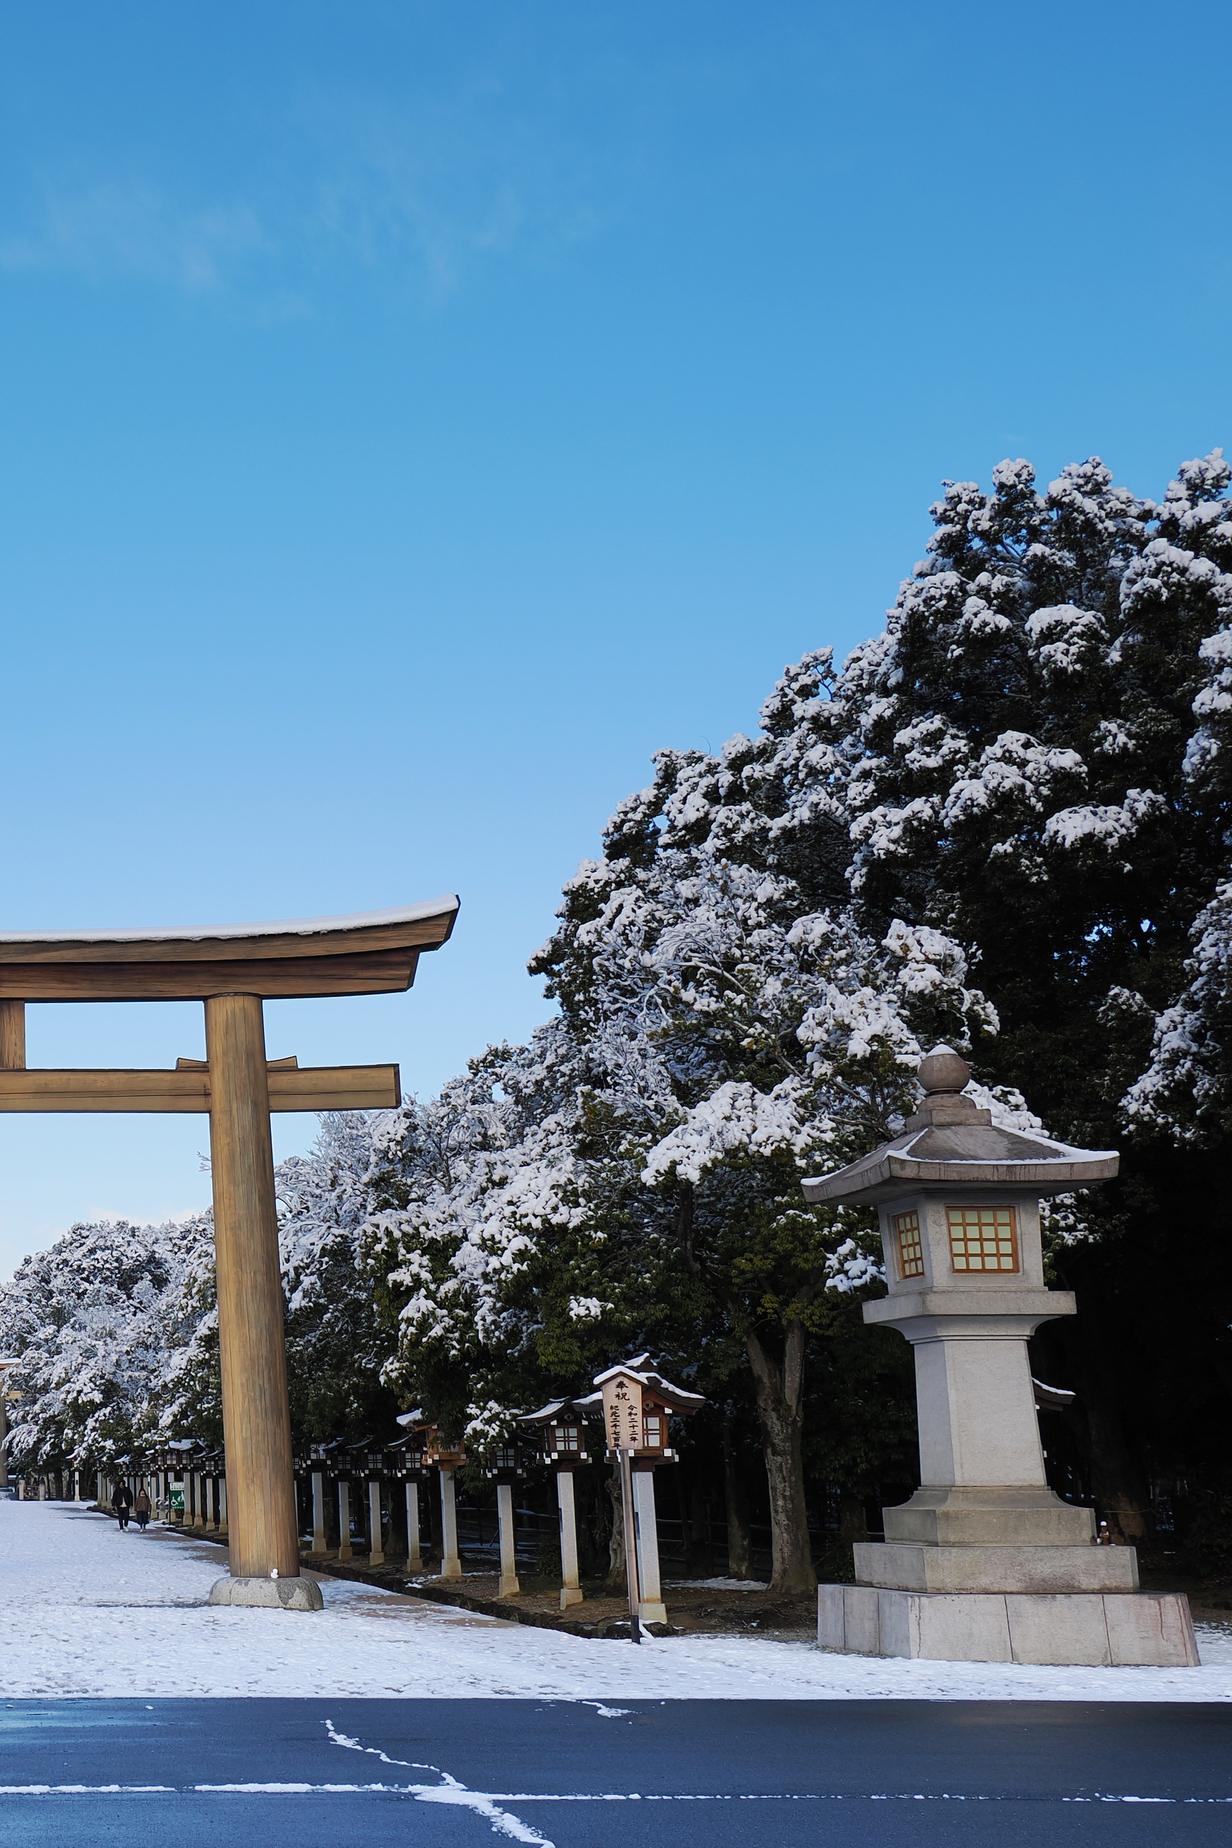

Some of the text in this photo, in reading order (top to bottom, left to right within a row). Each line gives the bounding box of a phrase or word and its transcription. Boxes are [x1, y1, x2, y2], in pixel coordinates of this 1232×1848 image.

[614, 1380, 630, 1401] 奉祝
[609, 1404, 621, 1449] 紀元二千七百年
[627, 1404, 638, 1443] 令和二十二年
